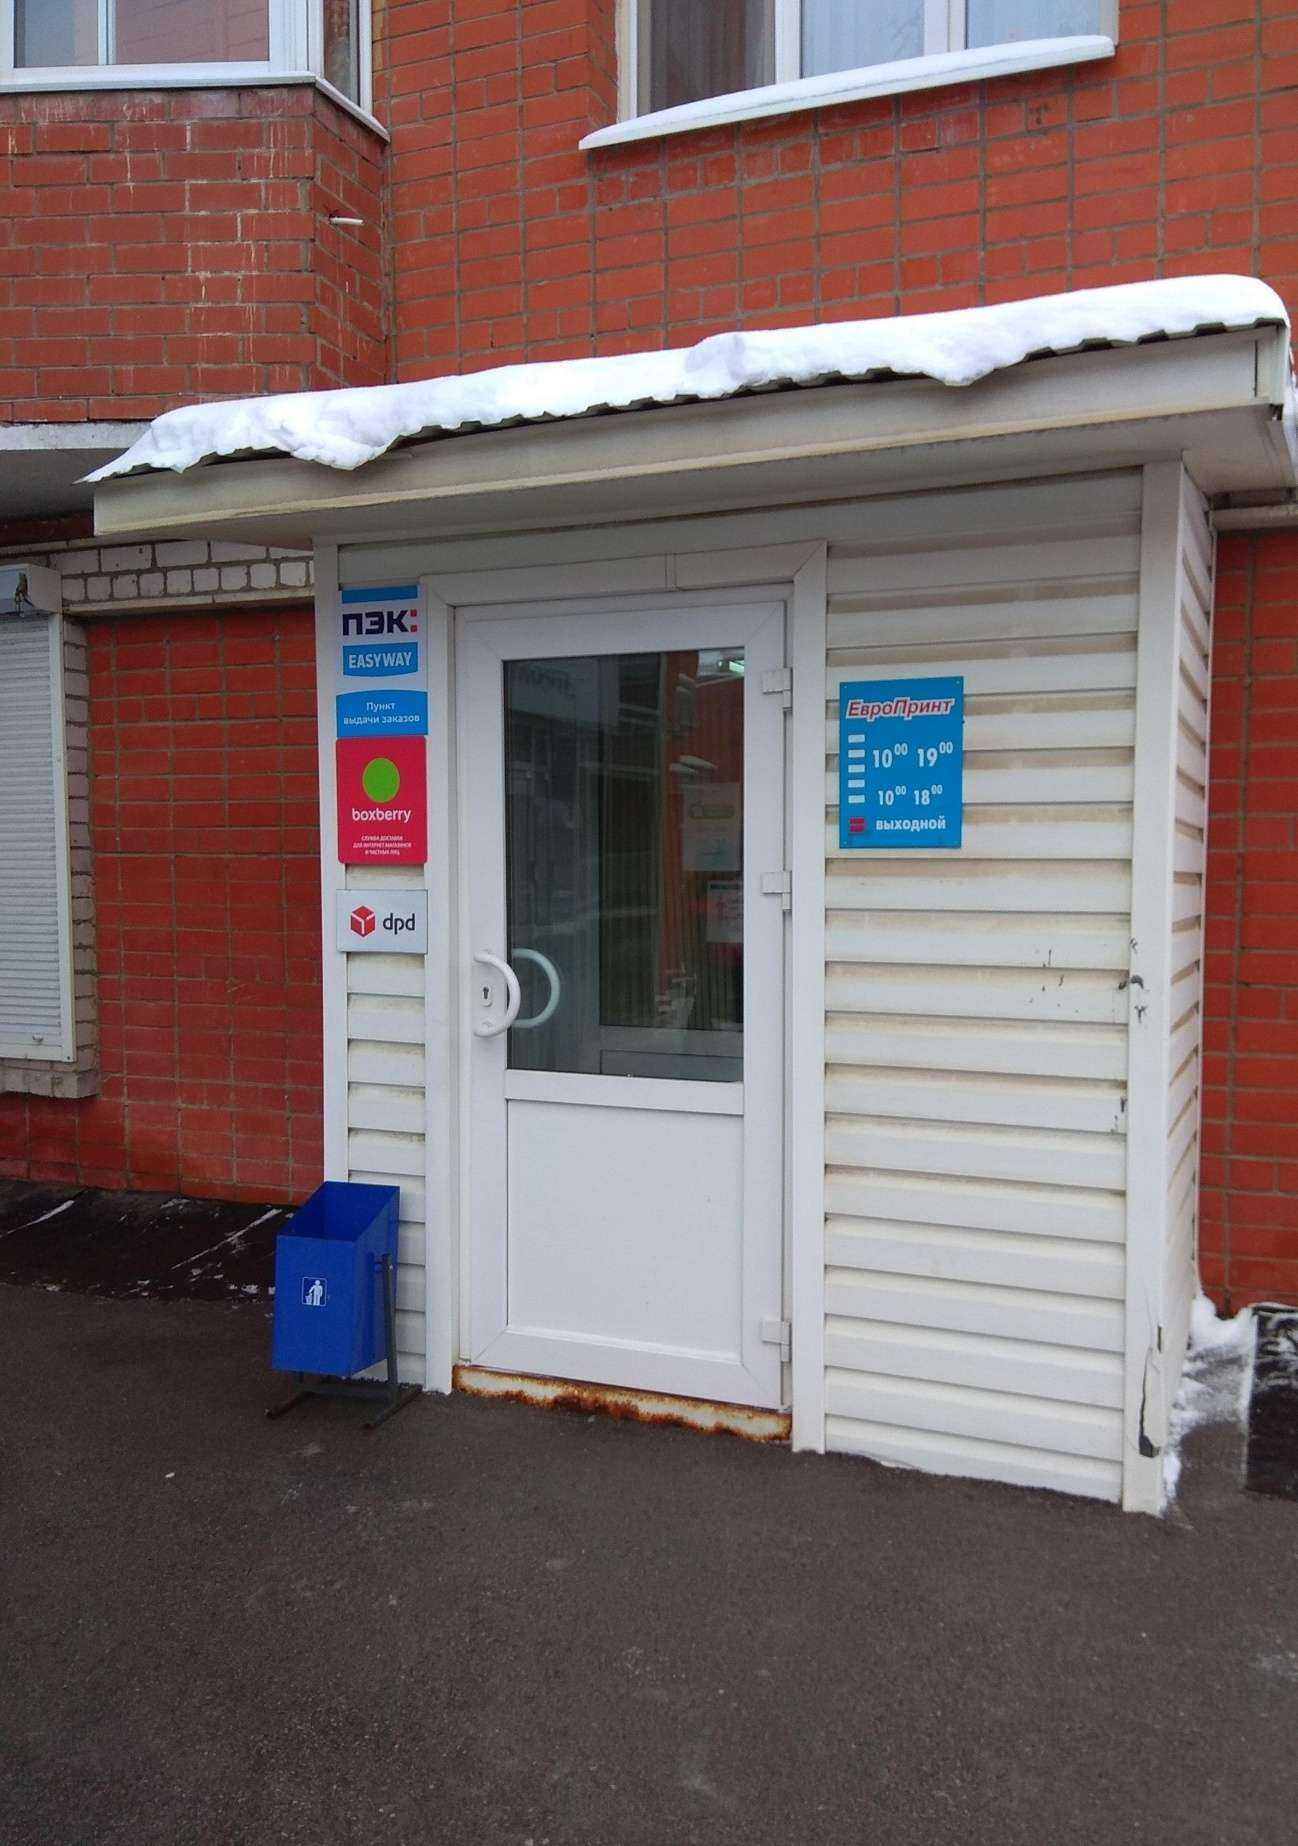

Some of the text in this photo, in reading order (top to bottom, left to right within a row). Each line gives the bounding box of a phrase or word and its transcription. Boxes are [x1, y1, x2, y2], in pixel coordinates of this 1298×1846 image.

[366, 702, 396, 713] Пункт
[846, 698, 954, 721] ЕвроПринт
[343, 714, 420, 725] выдачи заказов
[352, 808, 411, 823] boxberry
[383, 913, 416, 935] dpd
